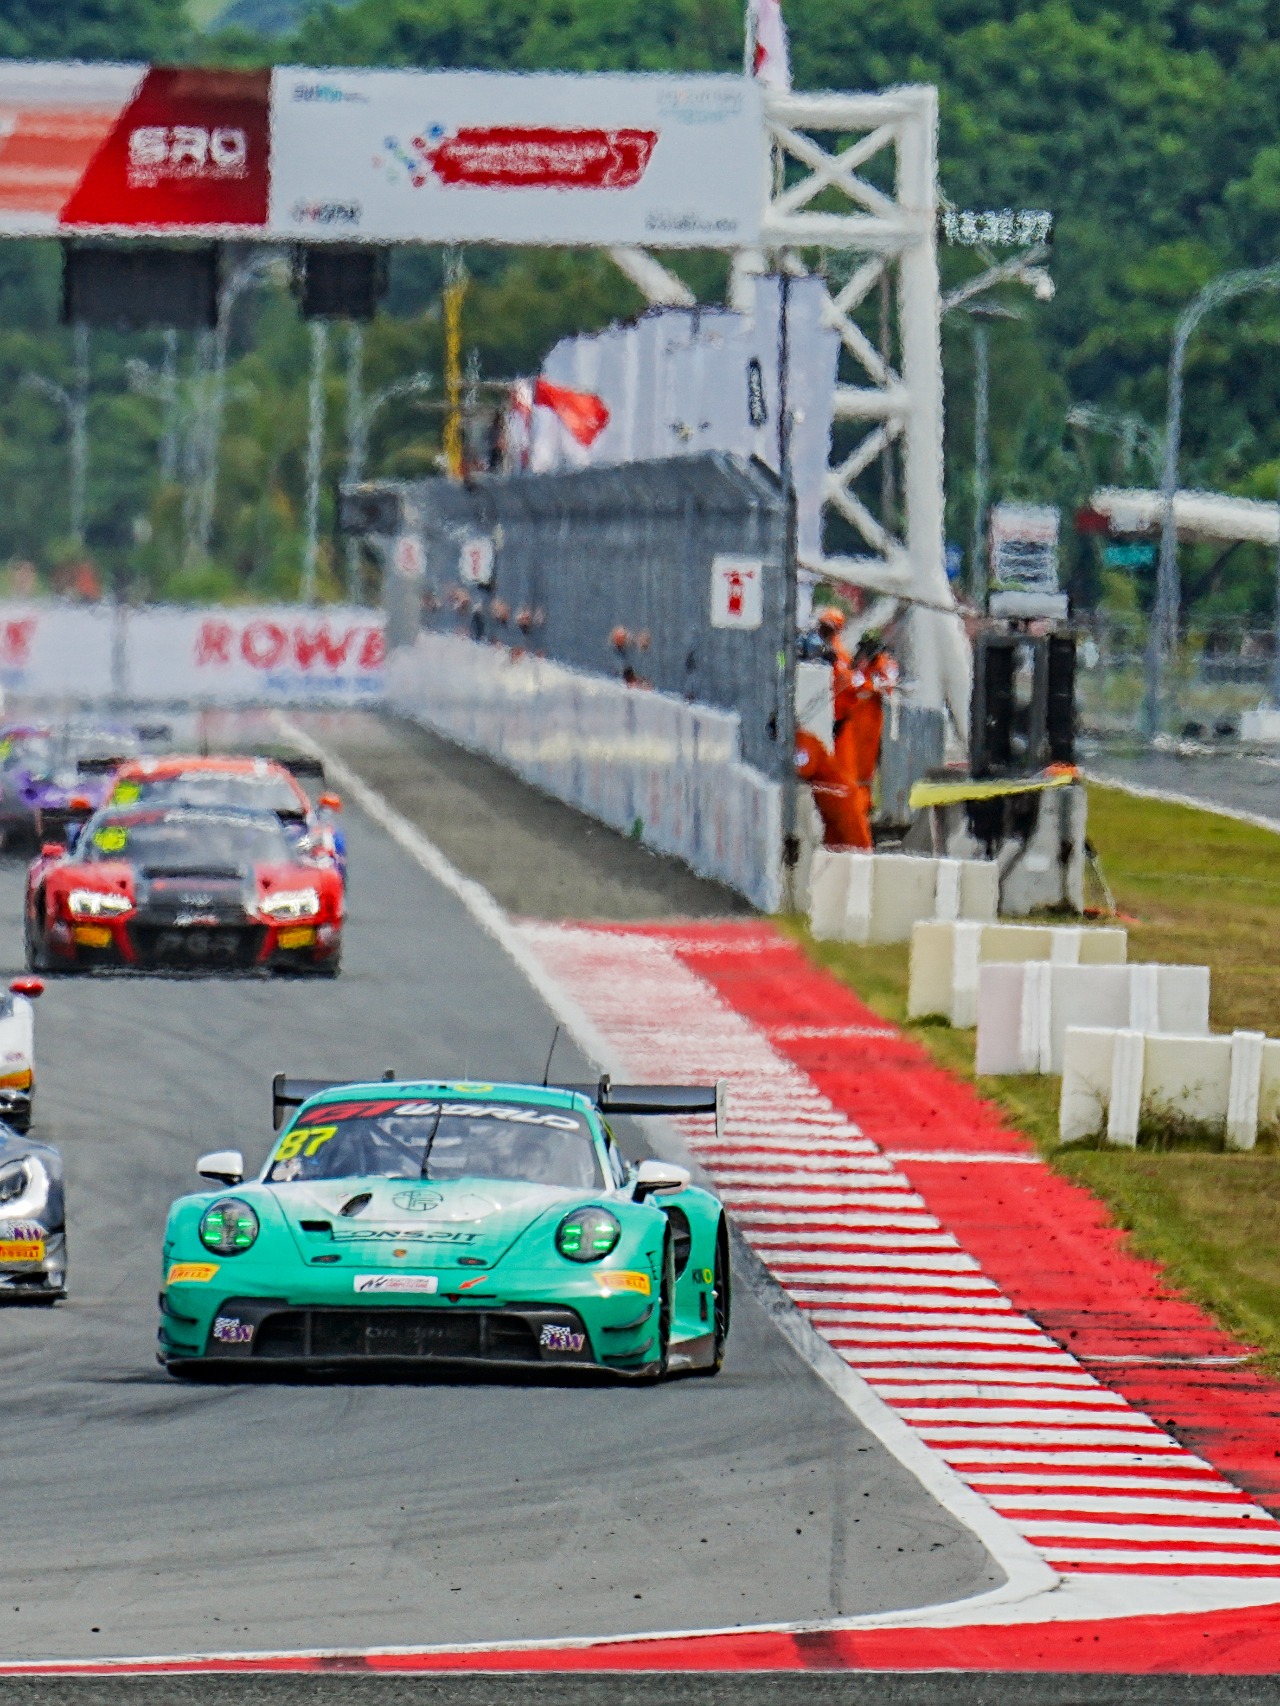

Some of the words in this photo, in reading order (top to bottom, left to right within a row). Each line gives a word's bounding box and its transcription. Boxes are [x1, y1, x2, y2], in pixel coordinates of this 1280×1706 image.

[129, 126, 246, 166] SRO
[196, 620, 386, 671] ROWE
[297, 1099, 436, 1125] GT
[393, 1102, 580, 1130] WORLD
[274, 1125, 339, 1162] 87
